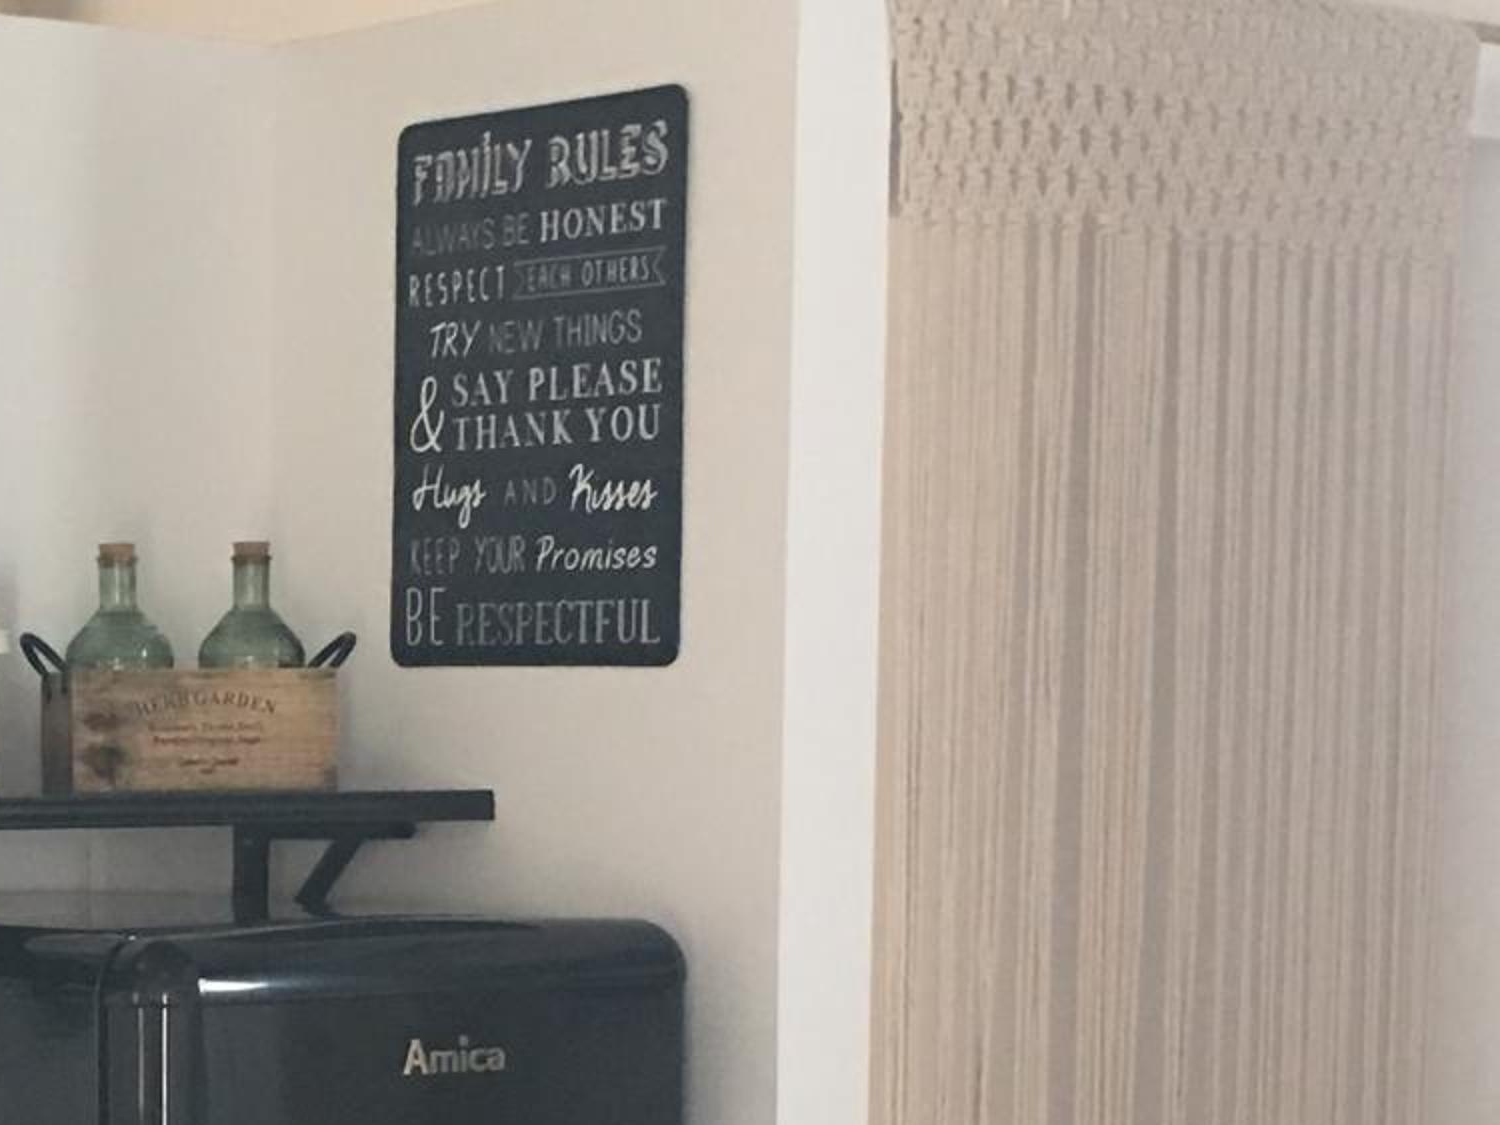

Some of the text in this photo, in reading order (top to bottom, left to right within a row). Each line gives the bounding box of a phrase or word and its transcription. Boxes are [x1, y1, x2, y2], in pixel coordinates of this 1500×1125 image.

[547, 120, 668, 188] RULES
[413, 198, 666, 256] ALWAYS BE HONEST
[408, 255, 649, 308] RESPECT EACH OTHERS
[429, 309, 642, 358] TRY NEW THINGS
[452, 357, 663, 407] SAY PLEASE
[410, 376, 445, 452] &
[452, 403, 660, 451] THANK YOU
[413, 463, 658, 529] Hugs AND Kisses
[410, 535, 658, 576] KEEP YOUR Promises
[406, 586, 660, 647] BE RESPECTFUL
[404, 1034, 506, 1075] Amica
